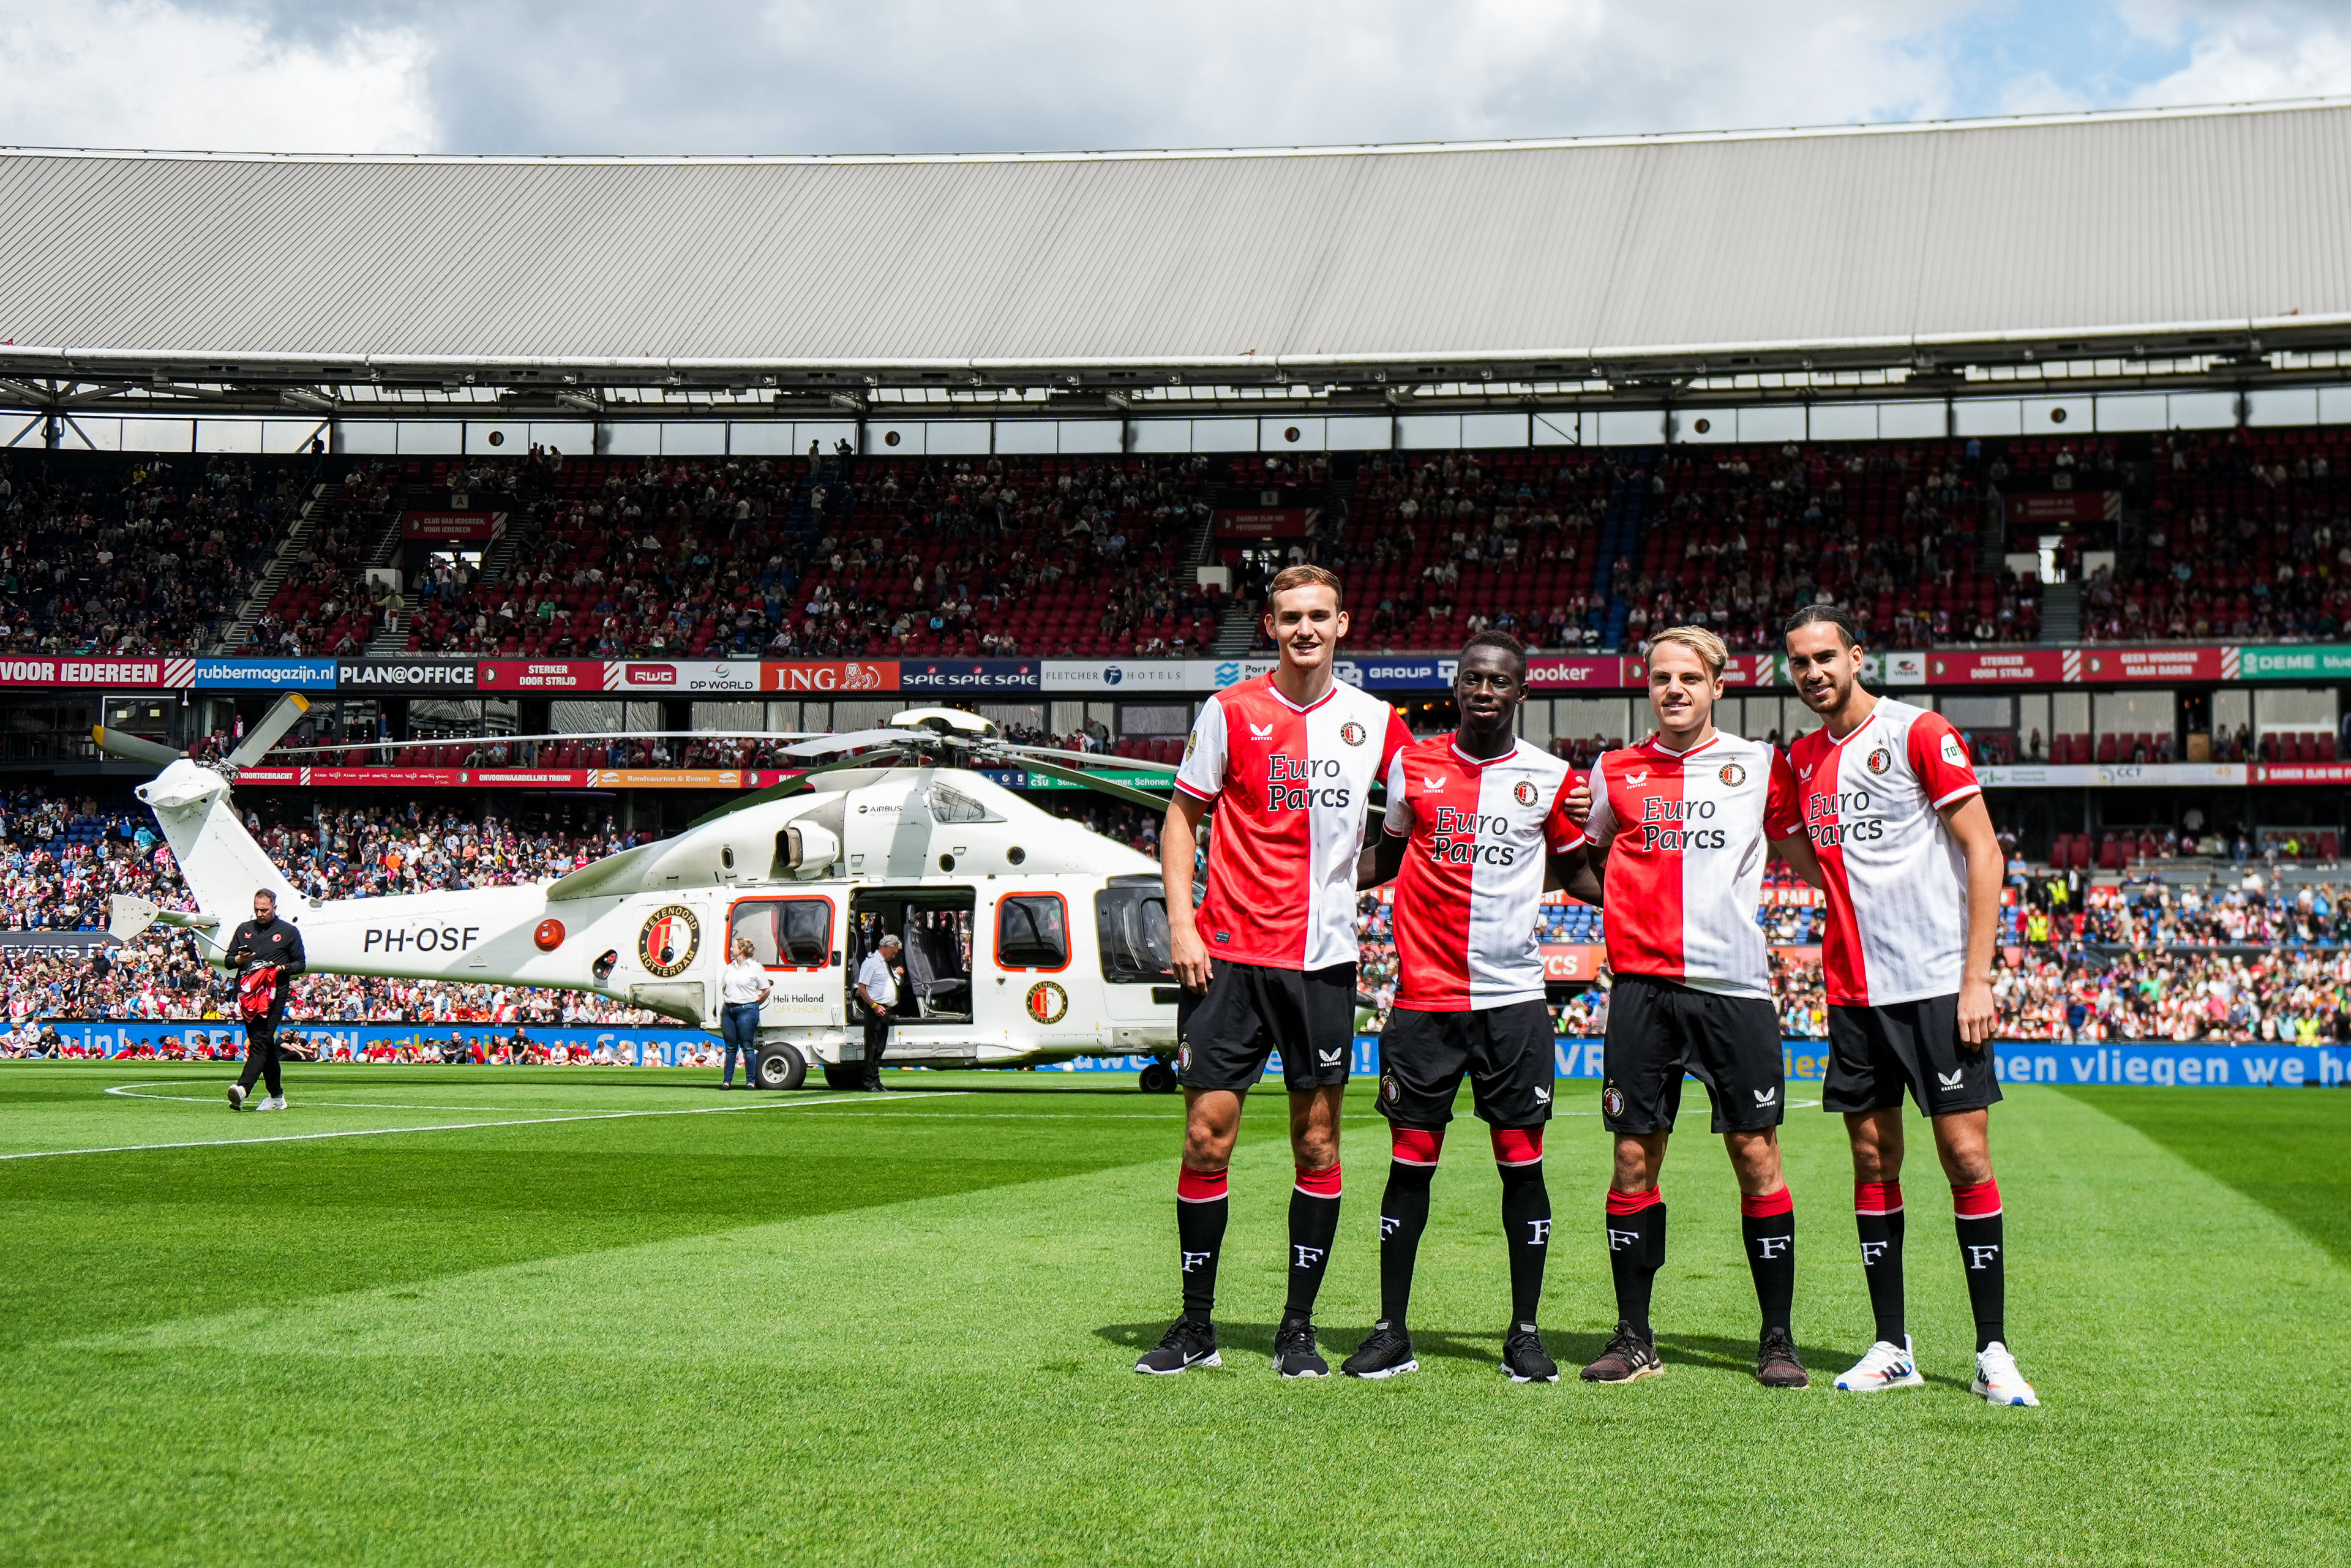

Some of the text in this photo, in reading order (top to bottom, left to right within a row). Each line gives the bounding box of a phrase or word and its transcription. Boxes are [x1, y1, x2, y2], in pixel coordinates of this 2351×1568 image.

[456, 497, 463, 505] A
[0, 662, 157, 683] VOOR IEDEREEN
[528, 665, 568, 674] STERKER
[1245, 665, 1266, 673] Port
[1369, 667, 1432, 678] GROUP
[1524, 664, 1591, 681] uooker
[2259, 655, 2315, 670] DEME
[197, 665, 334, 683] rubbermagazijn.nl
[340, 666, 474, 684] PLAN@OFFICE
[519, 677, 576, 685] DOOR STRIJD
[634, 672, 672, 681] RWG
[775, 668, 836, 691] ING
[902, 675, 1038, 686] SPIE SPIE SPIE
[690, 681, 753, 690] DP WORLD
[1268, 754, 1340, 781] Euro
[1134, 777, 1171, 786] Schoner.
[1267, 784, 1350, 811] Parcs
[1808, 792, 1870, 822] Euro
[1642, 795, 1715, 823] Euro
[1435, 806, 1508, 835] Euro
[1642, 825, 1725, 852] Parcs
[1808, 819, 1883, 847] Parcs
[1431, 837, 1515, 866] Parcs
[643, 906, 698, 933] FEYENOORD
[364, 927, 479, 952] PH-OSF
[640, 949, 696, 977] ROTTERDAM
[773, 994, 823, 1003] Heli Holland
[1028, 981, 1065, 997] FEYENOORD
[773, 1005, 824, 1014] OFFSHORE
[1029, 1007, 1066, 1024] ROTTERDAM
[2070, 1049, 2229, 1087] vliegen
[2241, 1057, 2304, 1084] we
[1527, 1218, 1551, 1245] F
[1607, 1229, 1639, 1251] F
[1294, 1245, 1324, 1269] F
[1757, 1234, 1790, 1259] F
[1861, 1240, 1887, 1266] F
[1968, 1244, 1998, 1269] F
[1182, 1251, 1210, 1273] F
